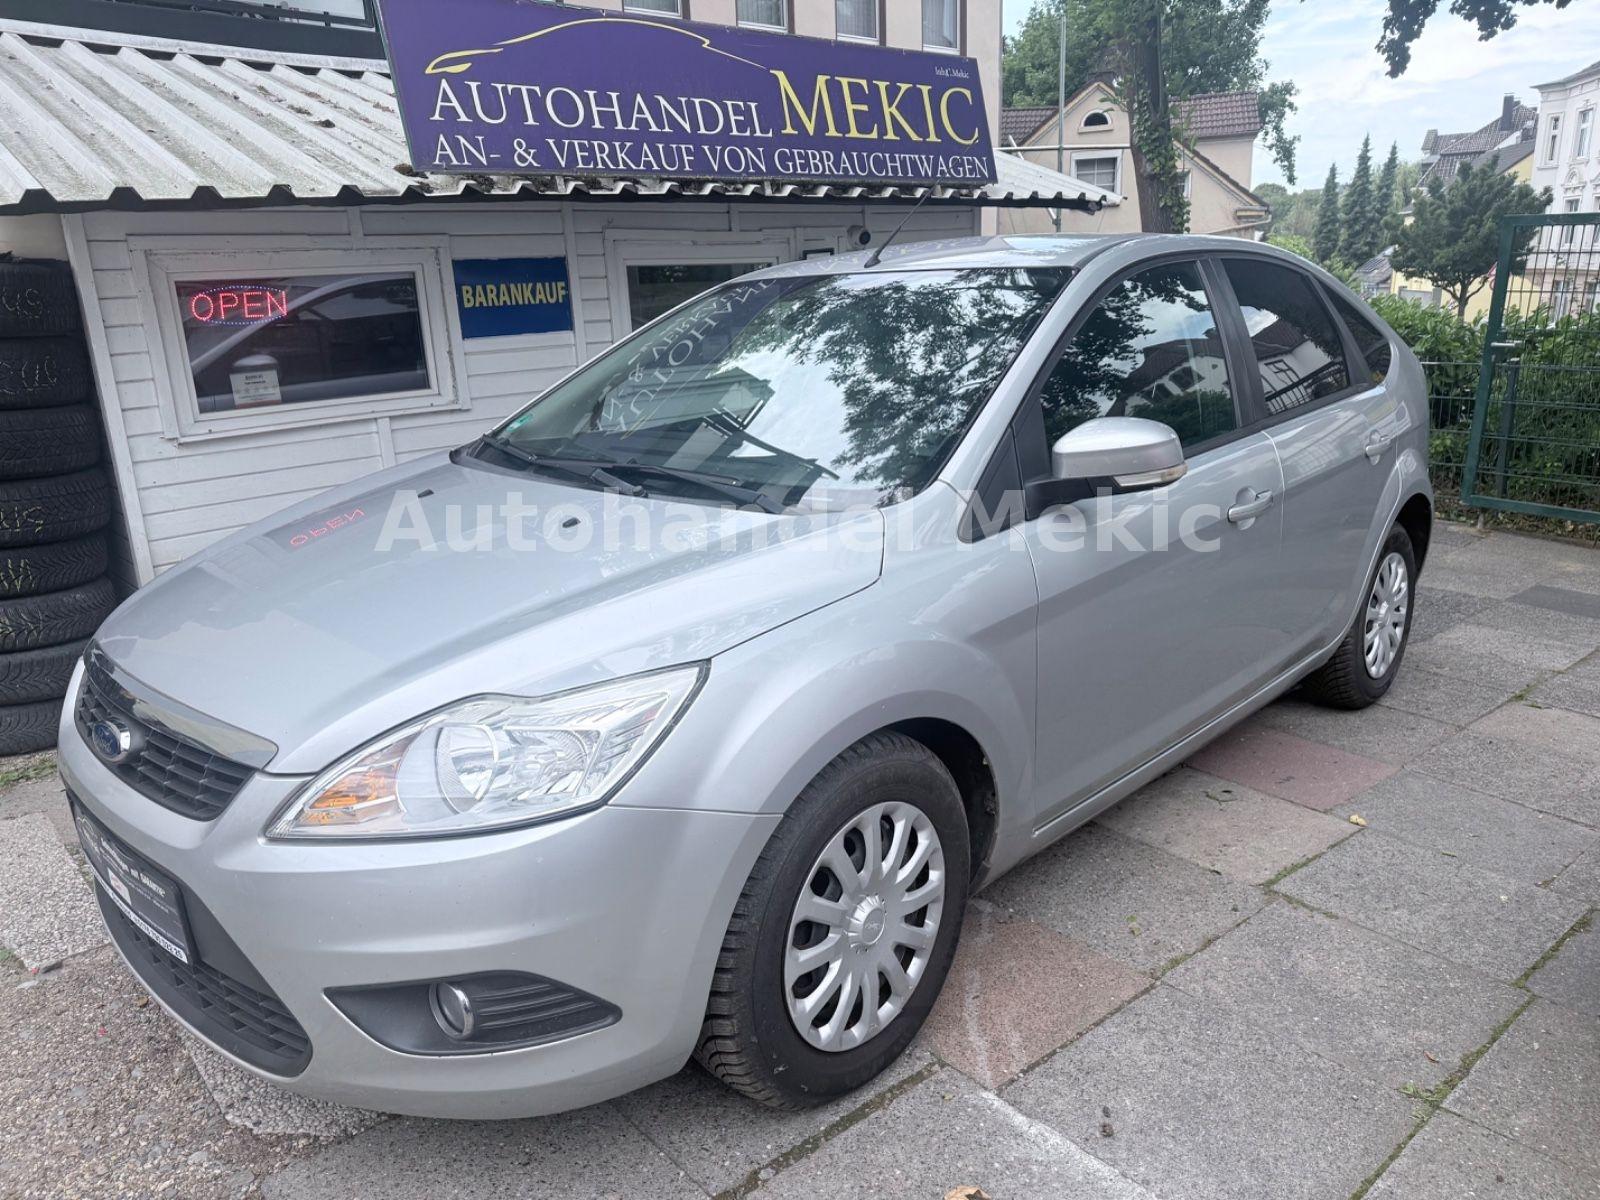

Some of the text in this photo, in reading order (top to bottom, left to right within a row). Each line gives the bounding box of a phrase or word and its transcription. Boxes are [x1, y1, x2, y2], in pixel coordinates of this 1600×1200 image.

[430, 69, 979, 145] AUTOHANDEL MEKIC
[433, 133, 989, 179] AN- & VERKAUF VON GEBRAUCHTWAGEN
[191, 290, 288, 321] OPEN
[461, 281, 566, 308] BARANKAUF
